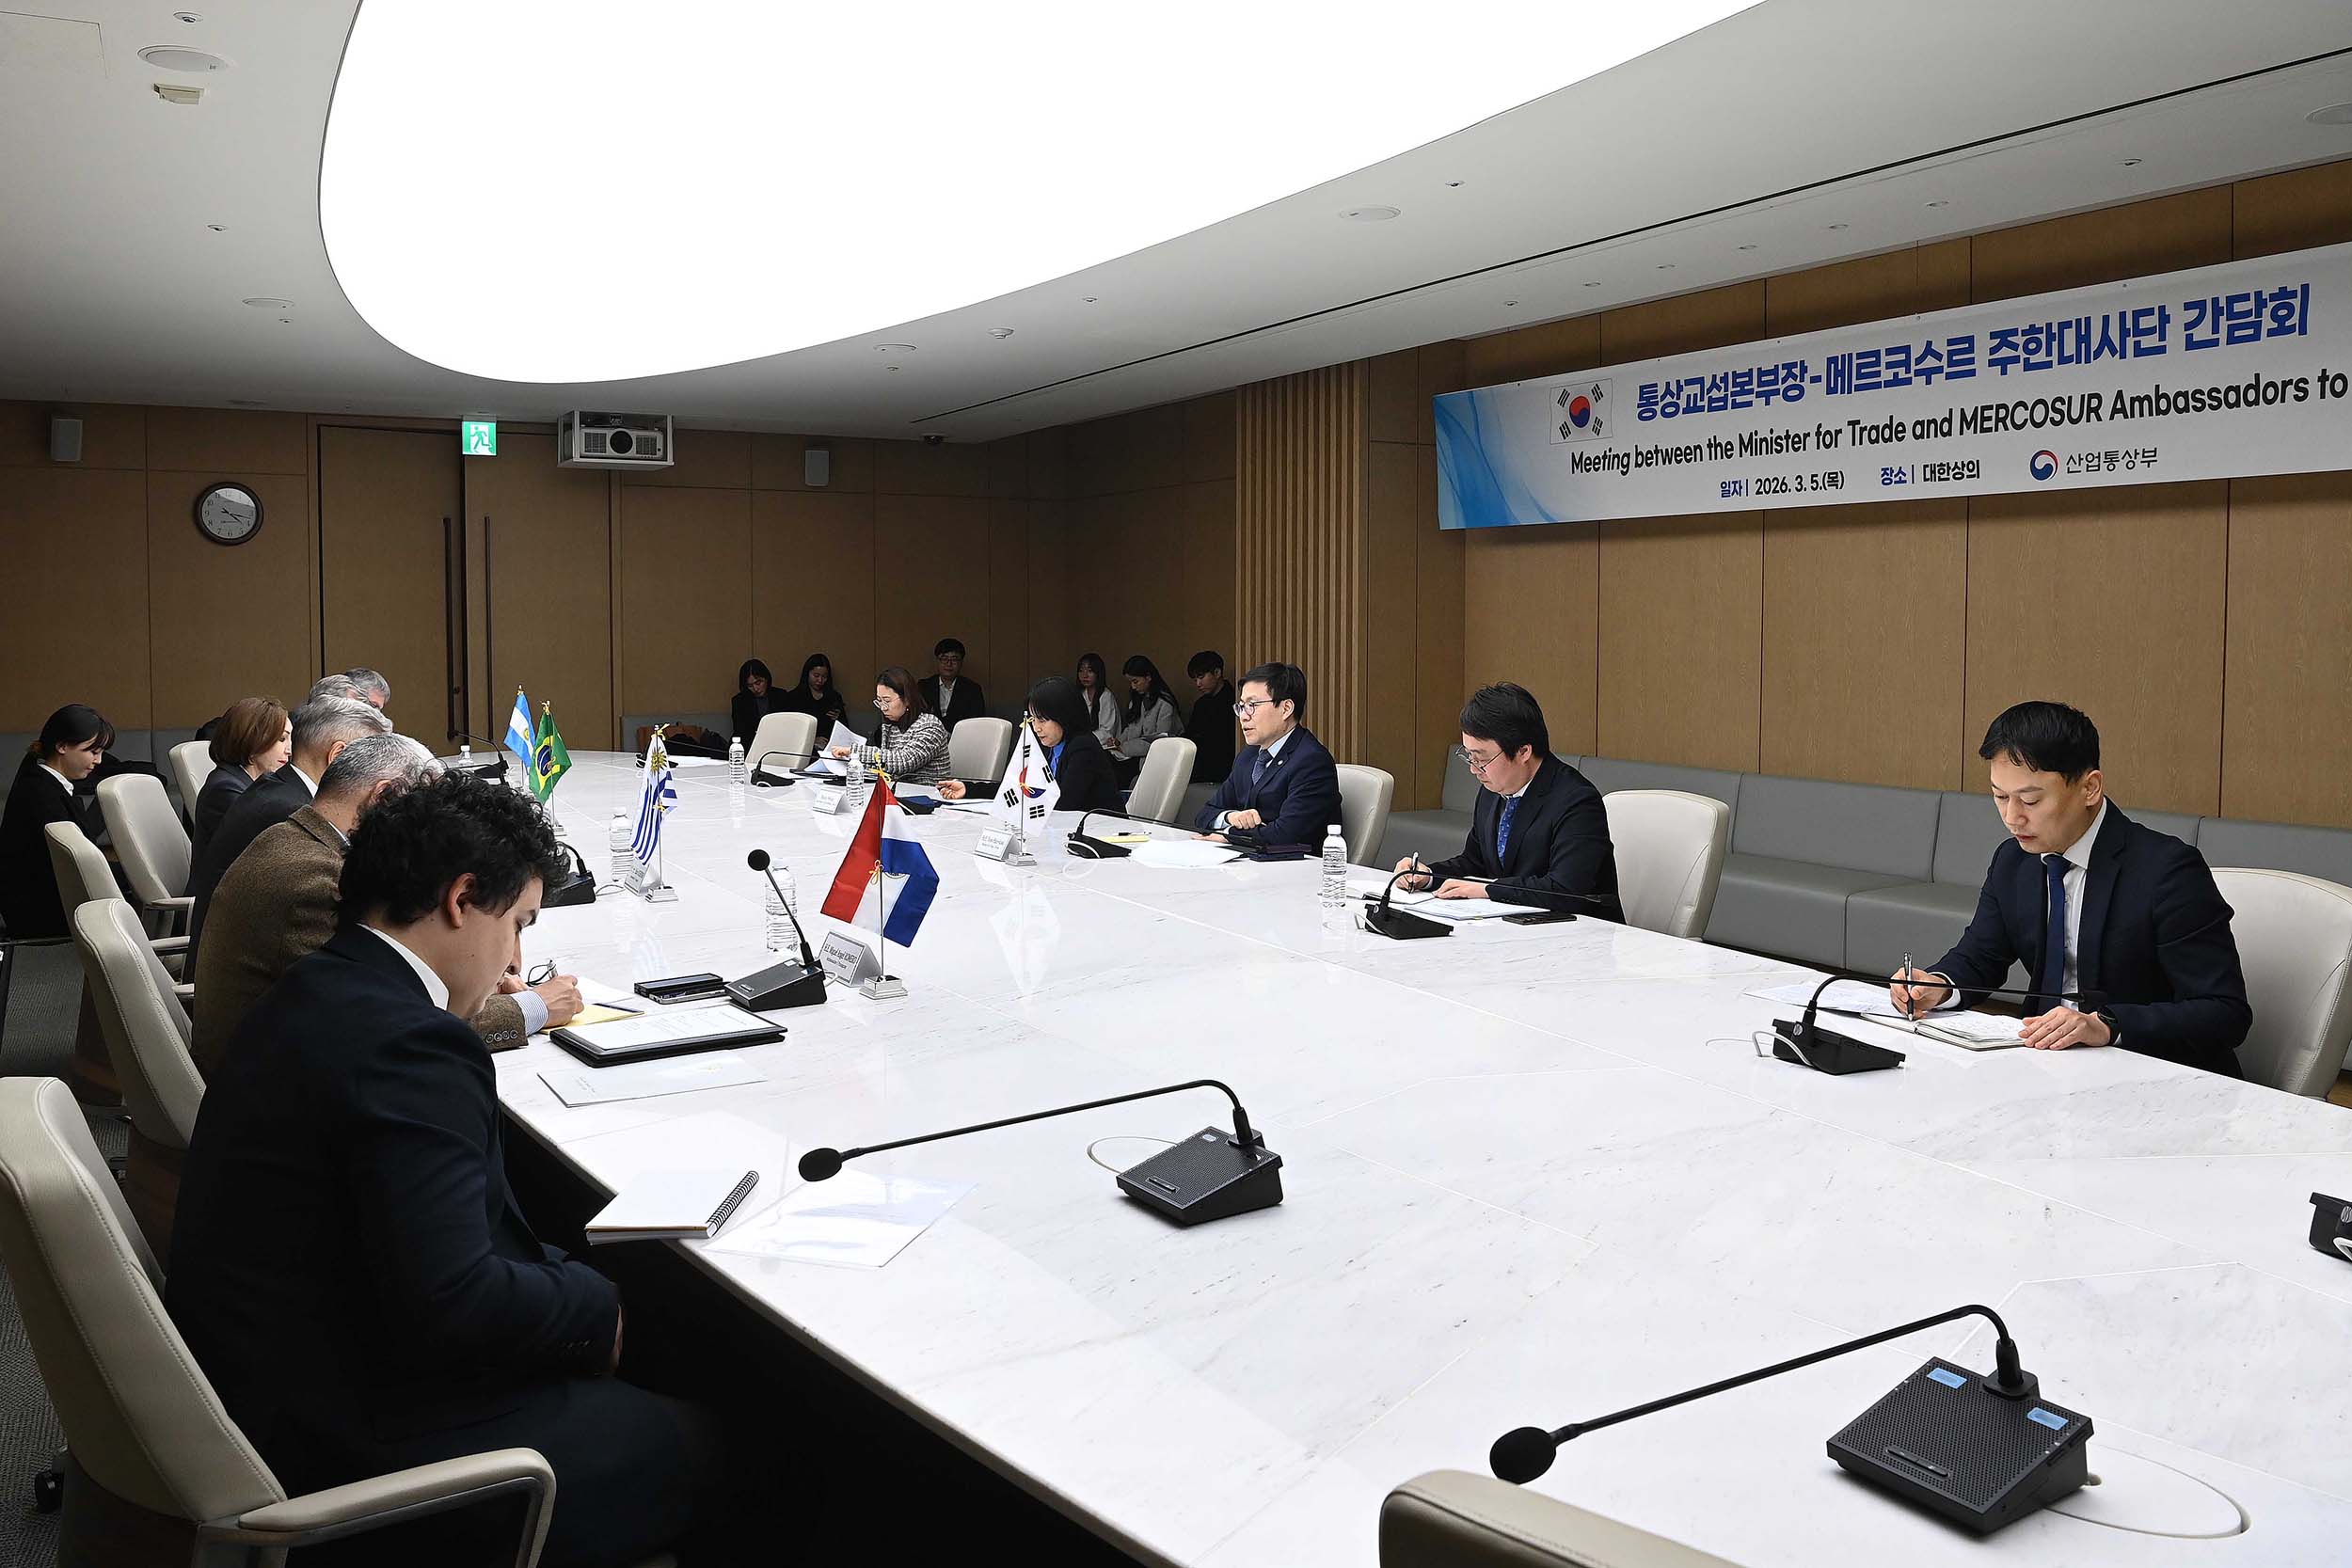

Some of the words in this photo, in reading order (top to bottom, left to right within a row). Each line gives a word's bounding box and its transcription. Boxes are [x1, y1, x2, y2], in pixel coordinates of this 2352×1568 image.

[1637, 335, 1977, 421] 통상교섭본부장-메르코수르
[1988, 305, 2170, 376] 주한대사단
[2184, 283, 2310, 352] 간담회
[1571, 447, 1630, 476] Meeting
[1634, 442, 1703, 468] between
[1707, 436, 1734, 461] the
[1739, 428, 1810, 458] Minister
[1815, 422, 1842, 451] for
[1847, 415, 1906, 447] Trade
[1912, 408, 1953, 441] and
[1959, 392, 2104, 436] MERCOSUR
[2109, 372, 2310, 421] Ambassadors
[2317, 368, 2348, 399] to
[1923, 459, 1980, 483] 대한상의
[2066, 447, 2158, 474] 산업통상부
[1755, 476, 1791, 496] 2026.
